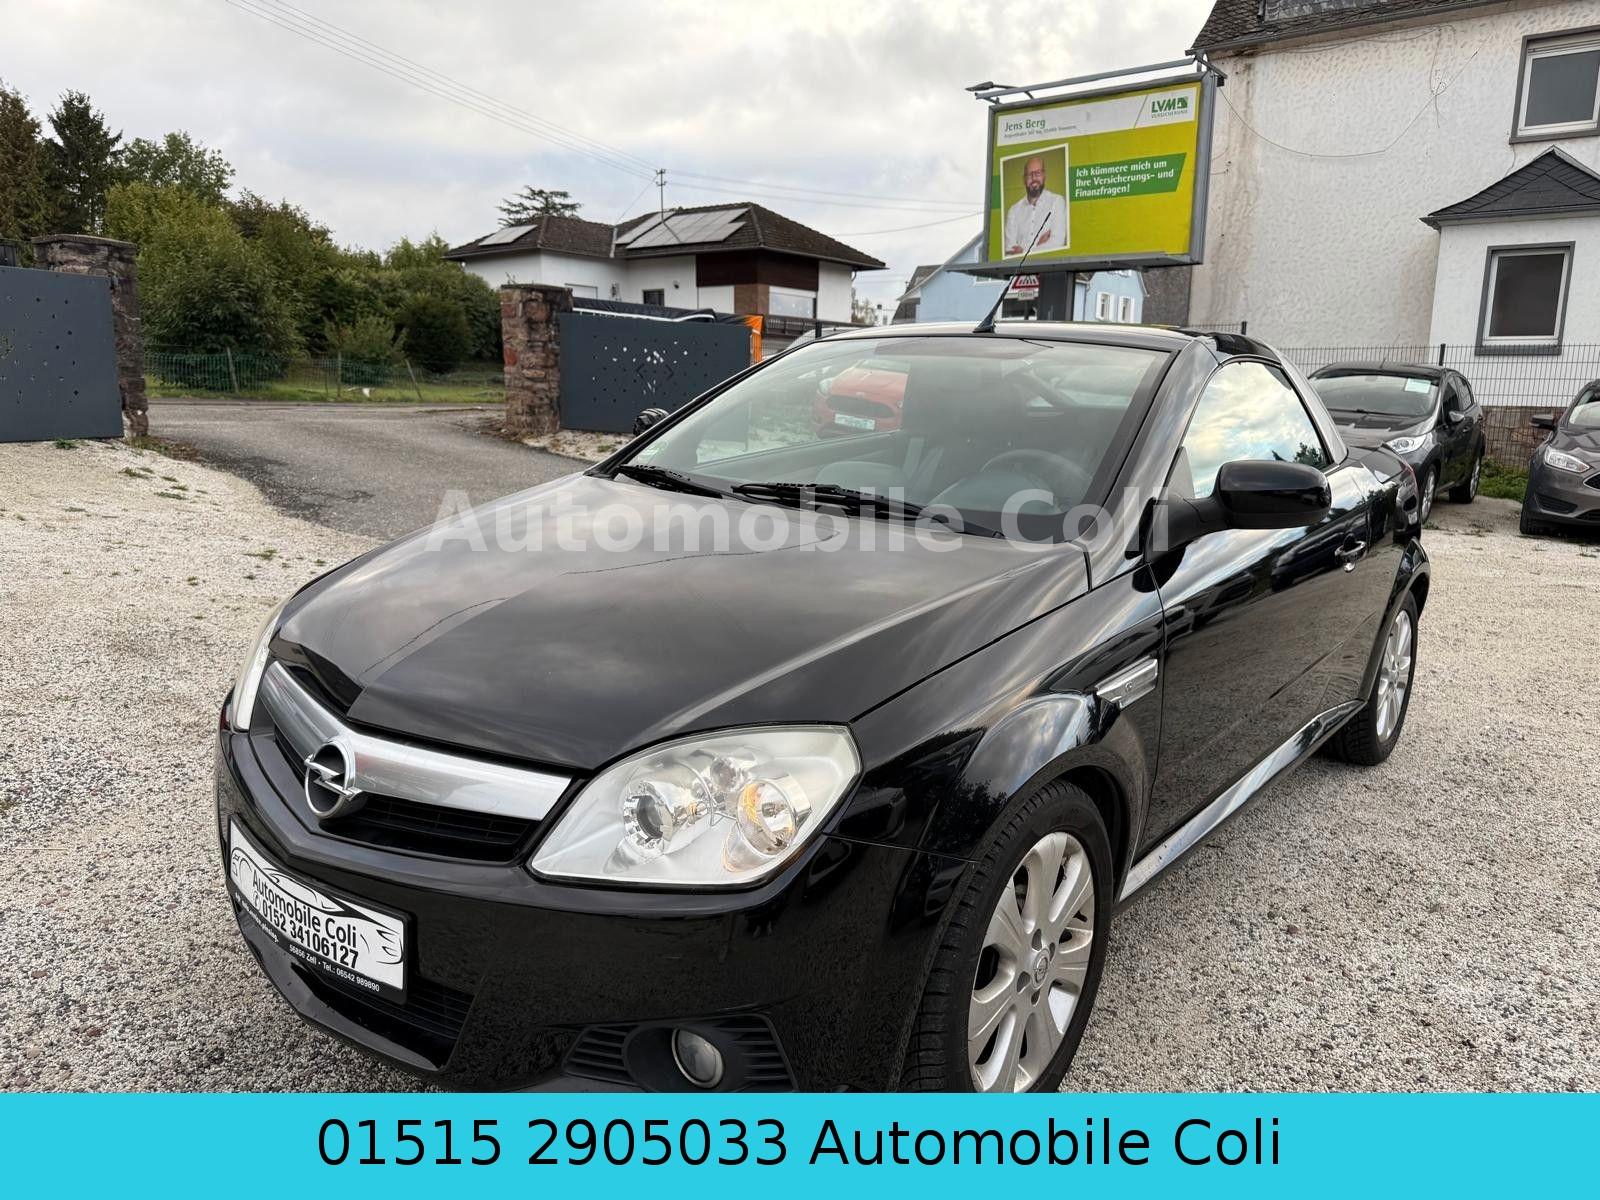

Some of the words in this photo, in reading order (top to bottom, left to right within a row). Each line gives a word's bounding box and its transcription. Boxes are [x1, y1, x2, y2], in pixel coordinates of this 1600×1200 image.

[1152, 97, 1176, 113] LVM
[1005, 122, 1023, 132] Jens
[1026, 119, 1045, 129] Berg
[1076, 168, 1088, 177] Ich
[1090, 164, 1128, 176] kümmere
[1131, 161, 1151, 171] mich
[1154, 160, 1167, 169] um
[1075, 178, 1091, 188] Ihre
[1094, 172, 1155, 186] Versicherungs-
[1158, 169, 1174, 178] und
[1075, 184, 1130, 198] Finanzfragen!
[252, 869, 321, 933] Automobile
[325, 917, 357, 948] Coli
[262, 900, 287, 932] 0152
[290, 922, 359, 969] 34106127
[306, 952, 317, 965] Zell
[322, 961, 336, 974] Tel.:
[336, 967, 355, 982] 06542
[356, 976, 380, 992] 989890
